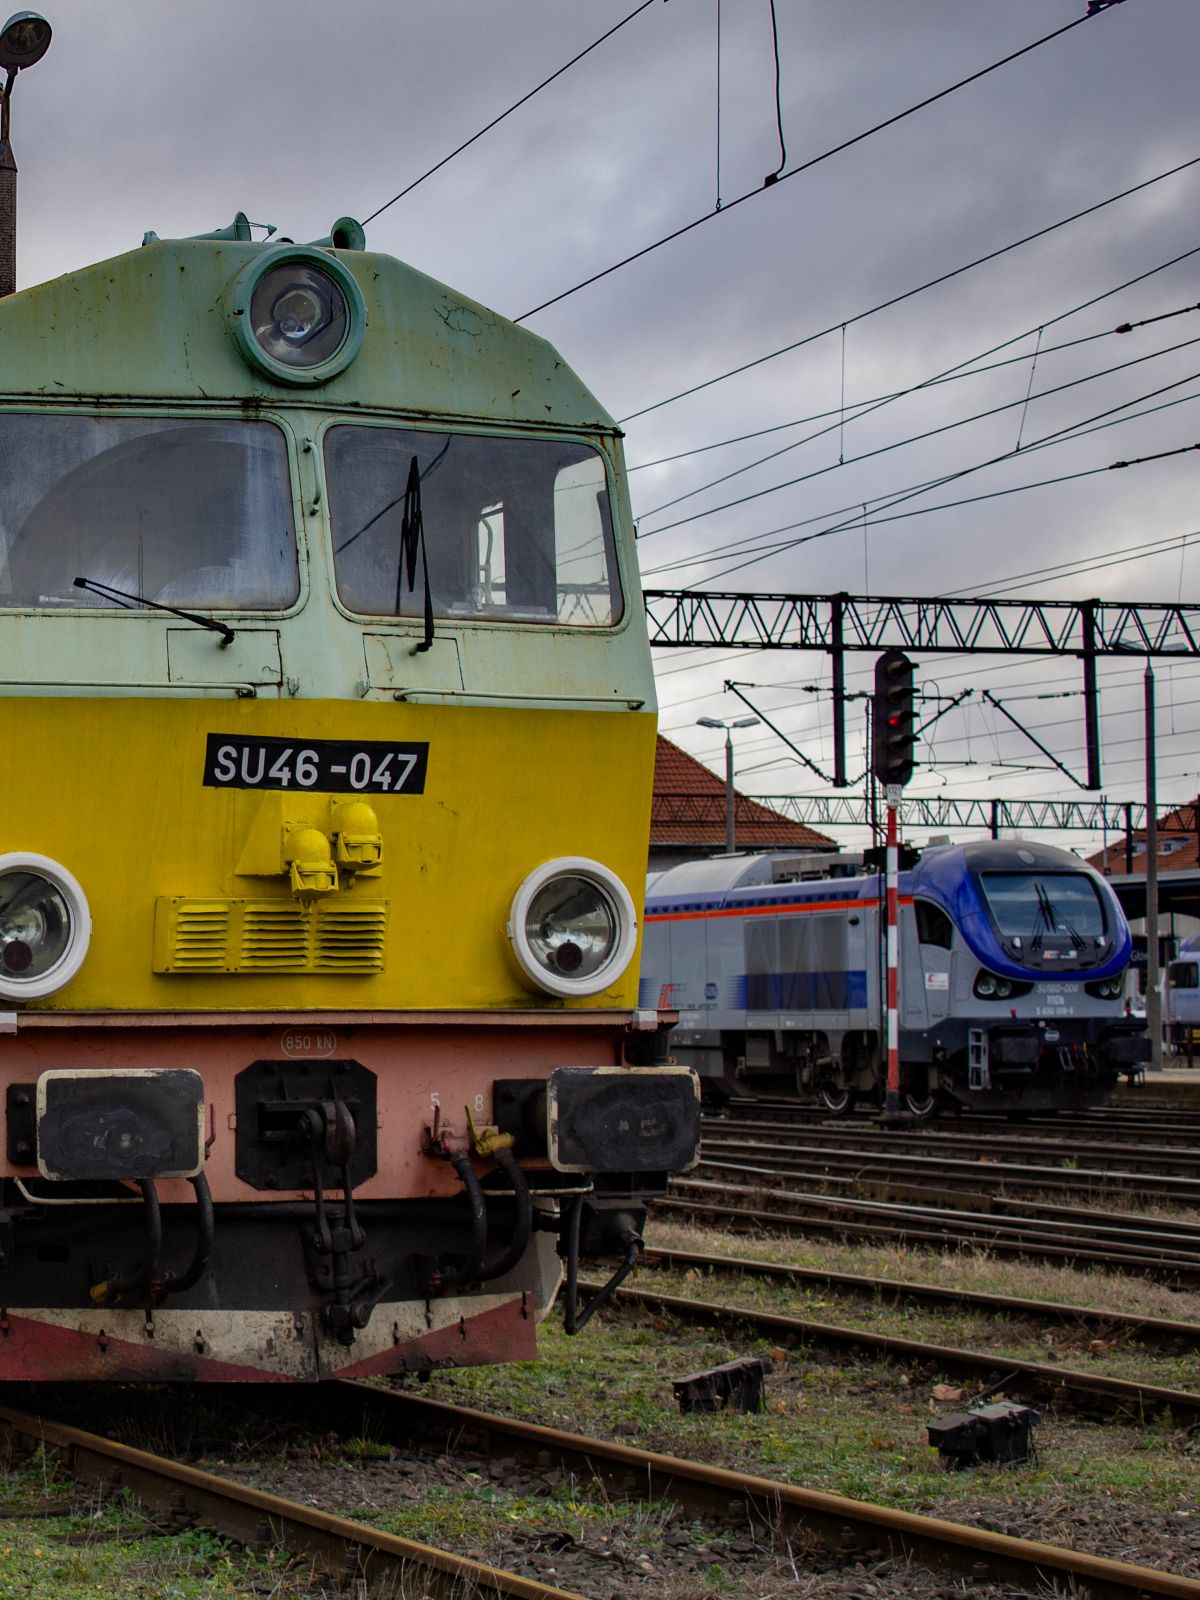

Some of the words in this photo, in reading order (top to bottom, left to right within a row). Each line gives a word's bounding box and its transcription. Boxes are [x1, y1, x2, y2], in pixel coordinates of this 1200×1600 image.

[286, 1036, 311, 1050] 850
[317, 1035, 332, 1049] kN
[430, 1092, 441, 1111] 5
[474, 1093, 485, 1112] 8
